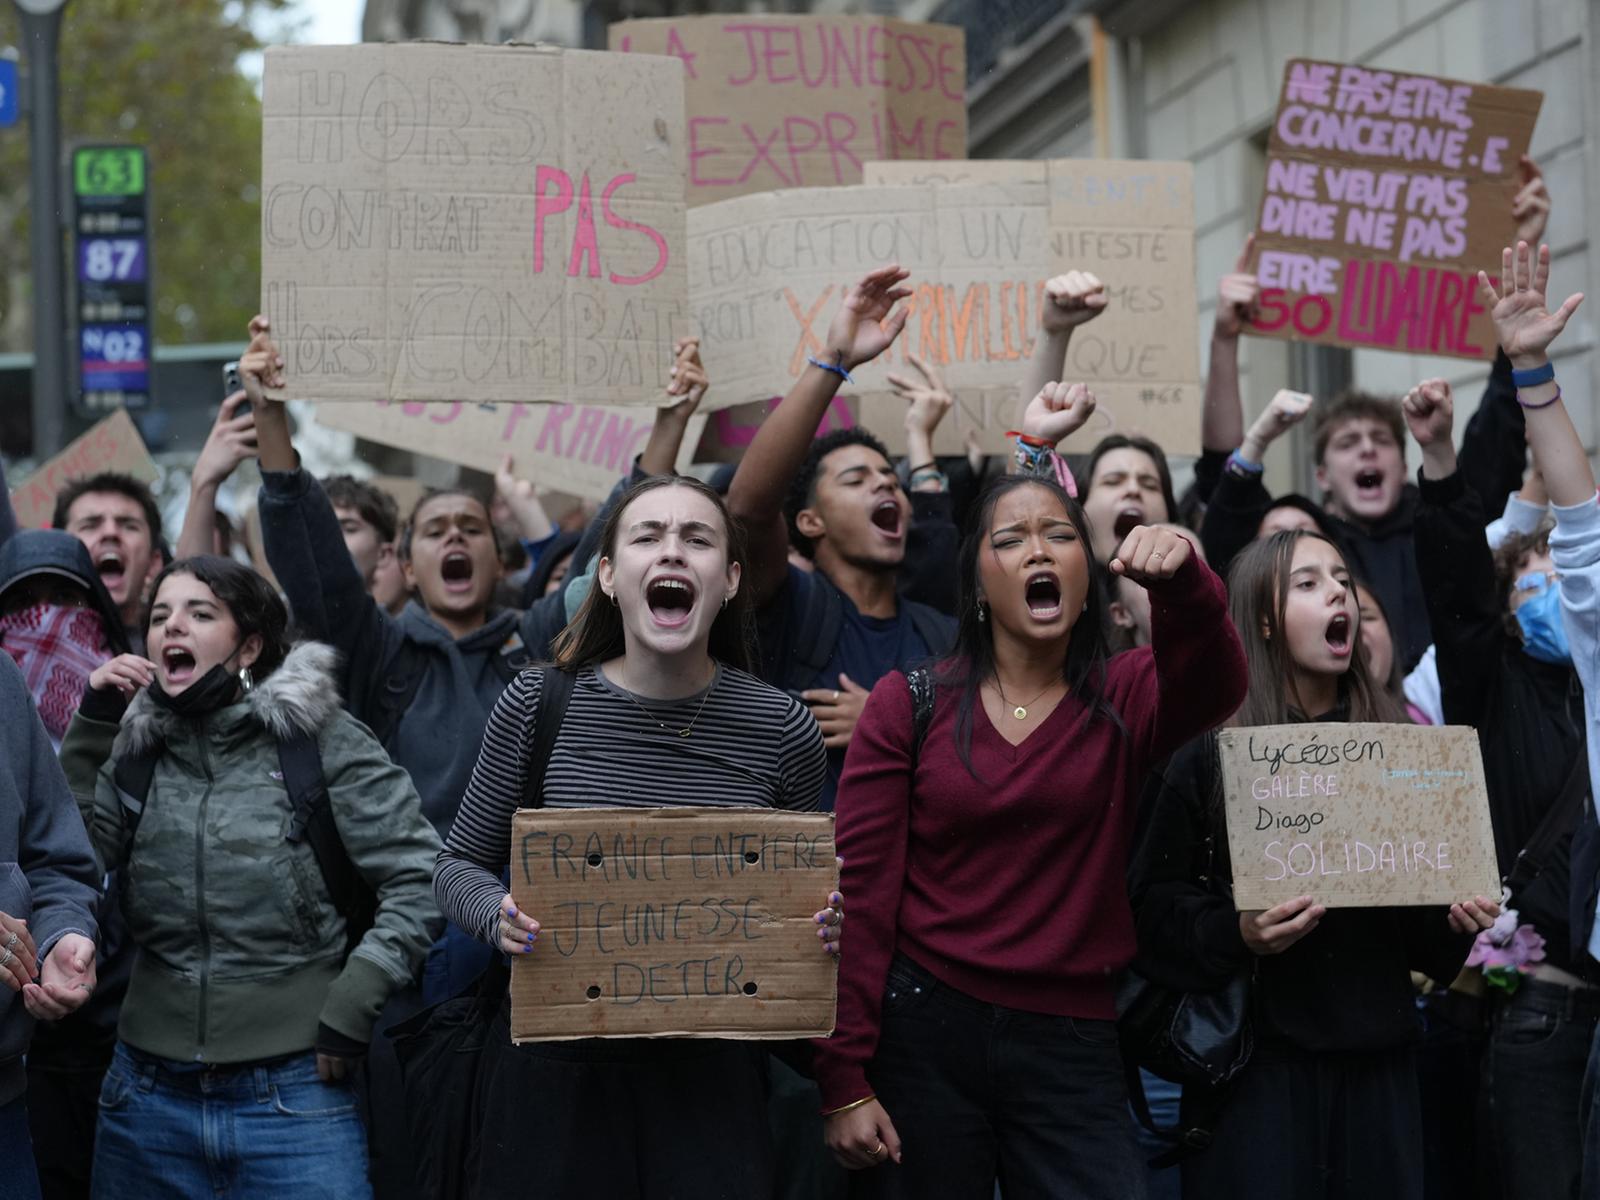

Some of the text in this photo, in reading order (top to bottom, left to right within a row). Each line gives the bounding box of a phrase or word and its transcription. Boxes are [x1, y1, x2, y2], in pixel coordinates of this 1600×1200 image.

[723, 23, 964, 101] JEUNESSE
[1286, 62, 1336, 104] NE
[1334, 65, 1393, 113] PAS
[298, 70, 547, 166] HORS
[1267, 159, 1469, 221] NE VEUT PAS
[265, 164, 669, 285] CONTRAT PAS
[961, 212, 1026, 260] UN
[1260, 195, 1468, 263] DIRE NE PAS
[86, 240, 140, 281] 87
[1257, 251, 1341, 295] ETRE
[405, 282, 681, 388] COMBAT
[1072, 334, 1168, 378] QUE
[1251, 770, 1340, 800] GALÈRE
[1255, 805, 1324, 834] Diago
[521, 831, 675, 886] FRANCE
[552, 898, 764, 957] JEUNESSE
[610, 955, 746, 1005] DETER
